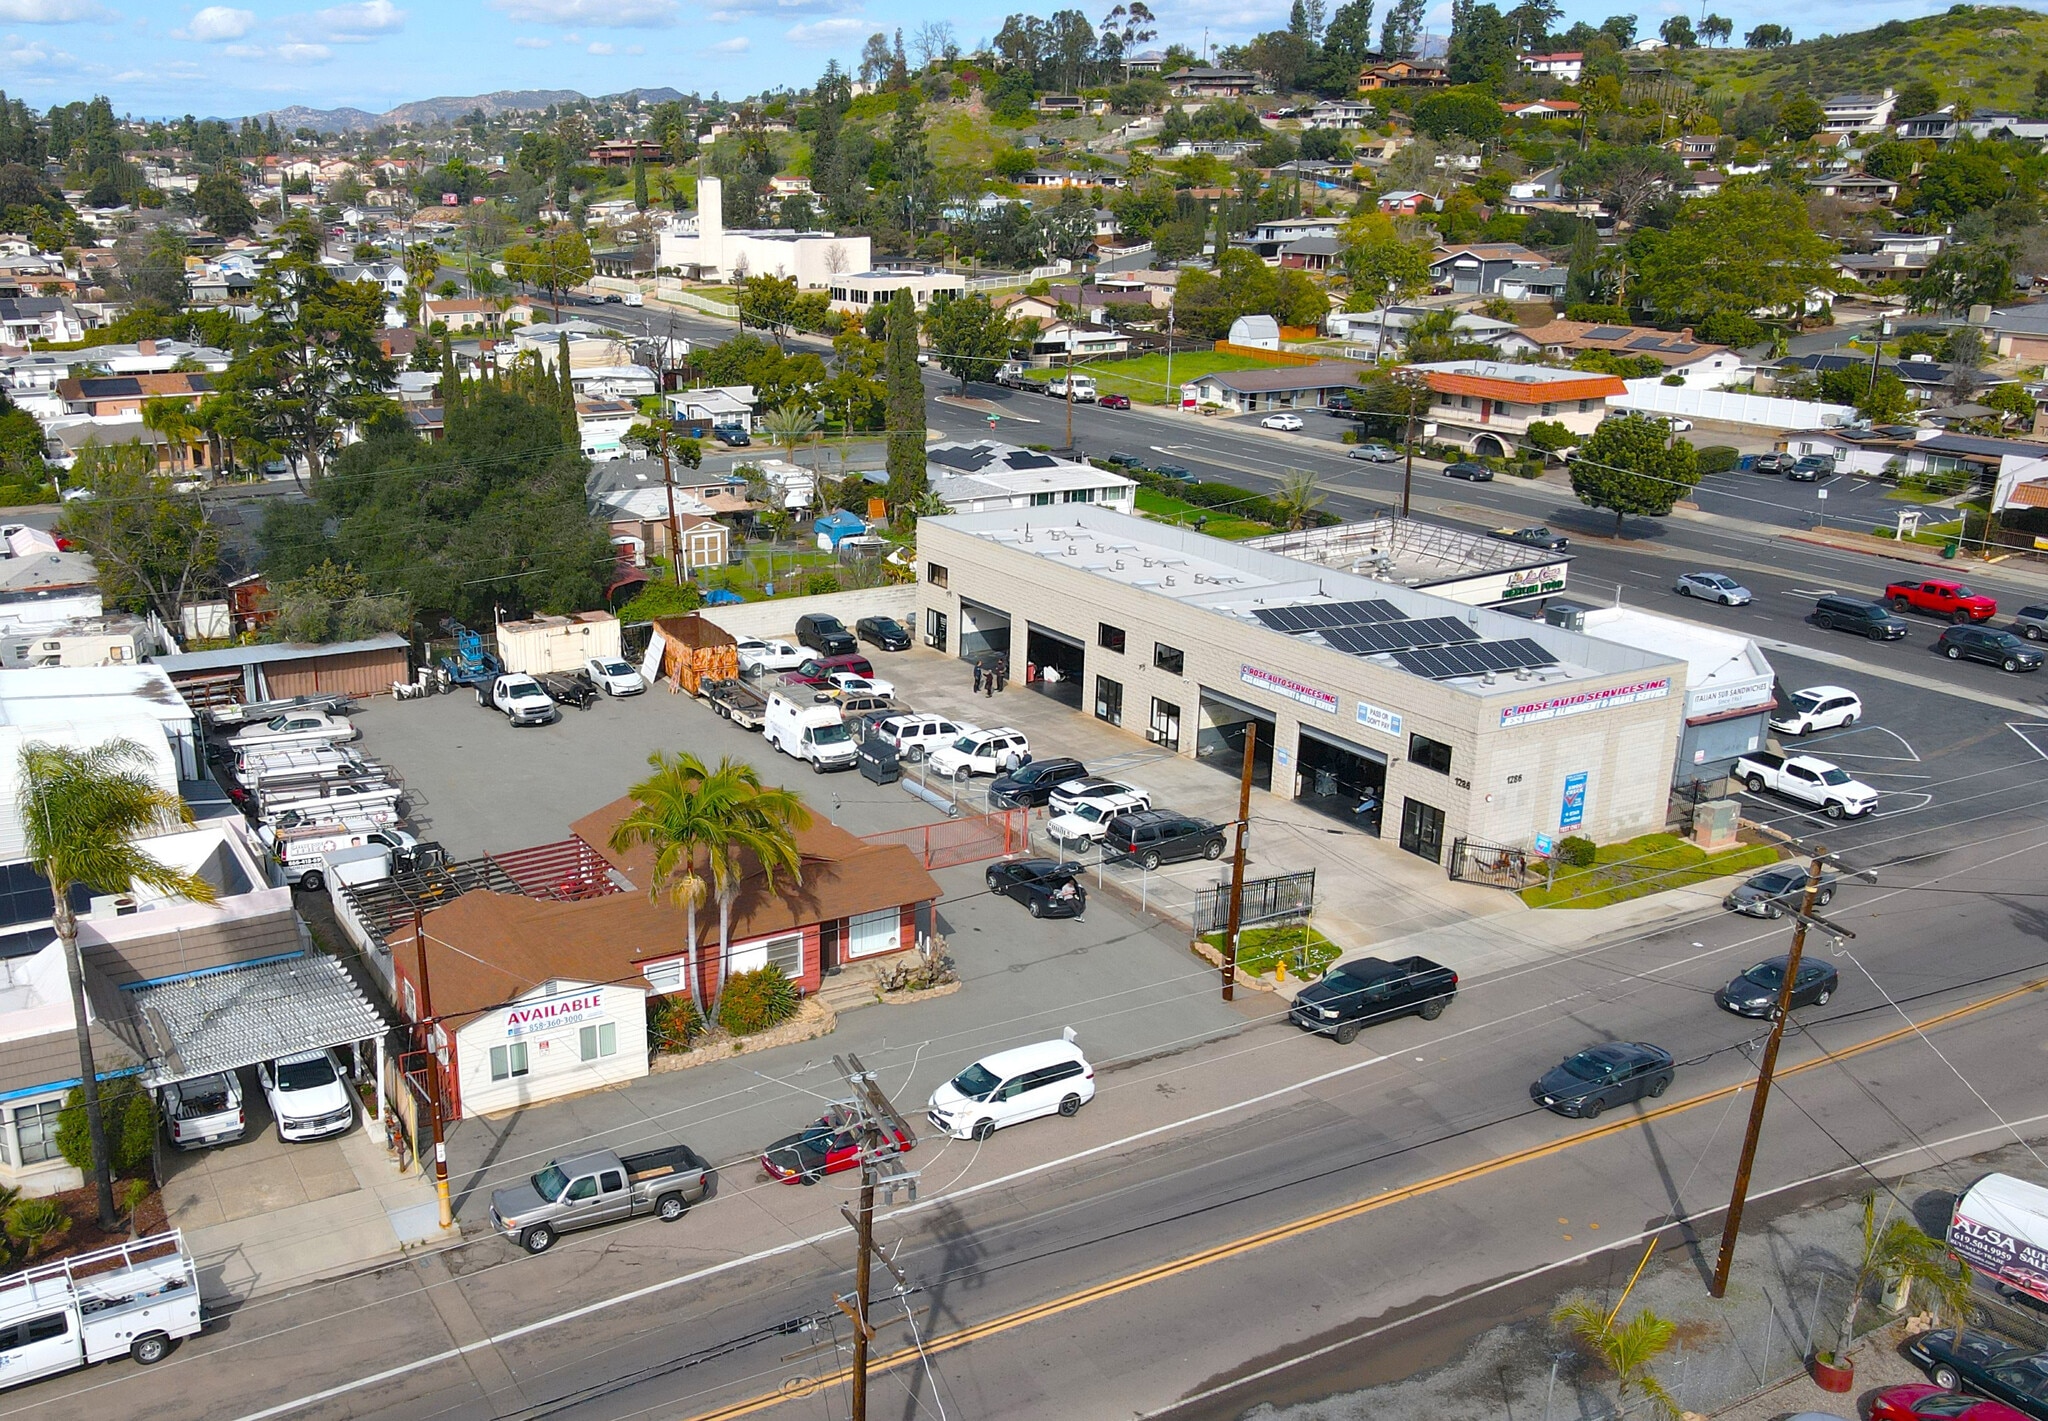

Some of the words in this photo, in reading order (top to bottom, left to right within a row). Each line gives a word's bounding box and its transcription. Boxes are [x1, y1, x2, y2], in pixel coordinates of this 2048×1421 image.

[1249, 667, 1268, 680] ROSE
[1268, 673, 1287, 686] AUTO
[1287, 680, 1323, 699] SERVICES
[1694, 693, 1717, 702] ITALIAN
[1718, 690, 1729, 698] SUB
[1730, 682, 1767, 697] SANDWICHES
[1516, 701, 1550, 715] ROSE
[1551, 694, 1586, 708] AUTO
[1586, 683, 1645, 702] SERVICES
[1635, 687, 1669, 702] SERVICE
[1367, 716, 1381, 726] DON'T
[1381, 721, 1390, 730] PAY
[1370, 708, 1381, 718] PASS
[1382, 712, 1389, 720] OR
[1454, 776, 1471, 790] 1286
[1506, 774, 1523, 784] 1286
[508, 994, 601, 1026] AVAILABLE
[529, 1014, 583, 1032] 858-360-3000
[1953, 1220, 2017, 1254] ALSA
[1954, 1232, 2012, 1262] 619.504.9959
[2023, 1246, 2048, 1262] AUT
